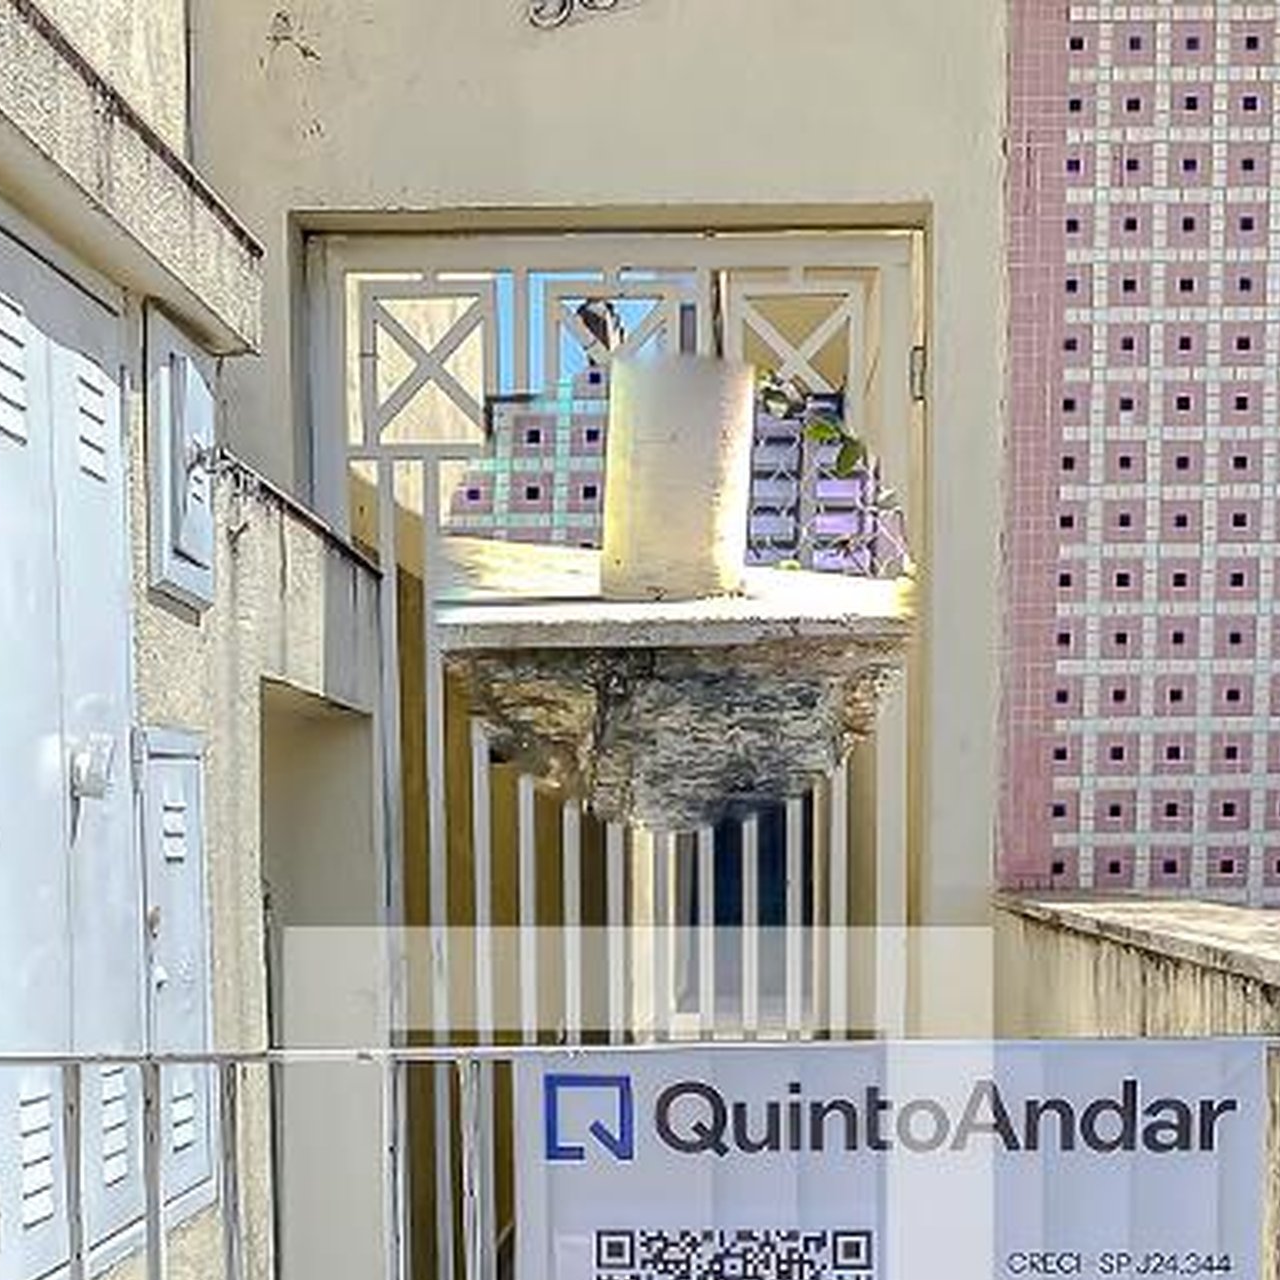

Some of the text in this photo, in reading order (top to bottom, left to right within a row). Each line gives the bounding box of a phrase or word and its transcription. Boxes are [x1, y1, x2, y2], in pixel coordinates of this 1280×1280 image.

[654, 1079, 1237, 1157] QuintoAndar
[1007, 1252, 1082, 1275] CRECI
[1099, 1252, 1131, 1275] SP
